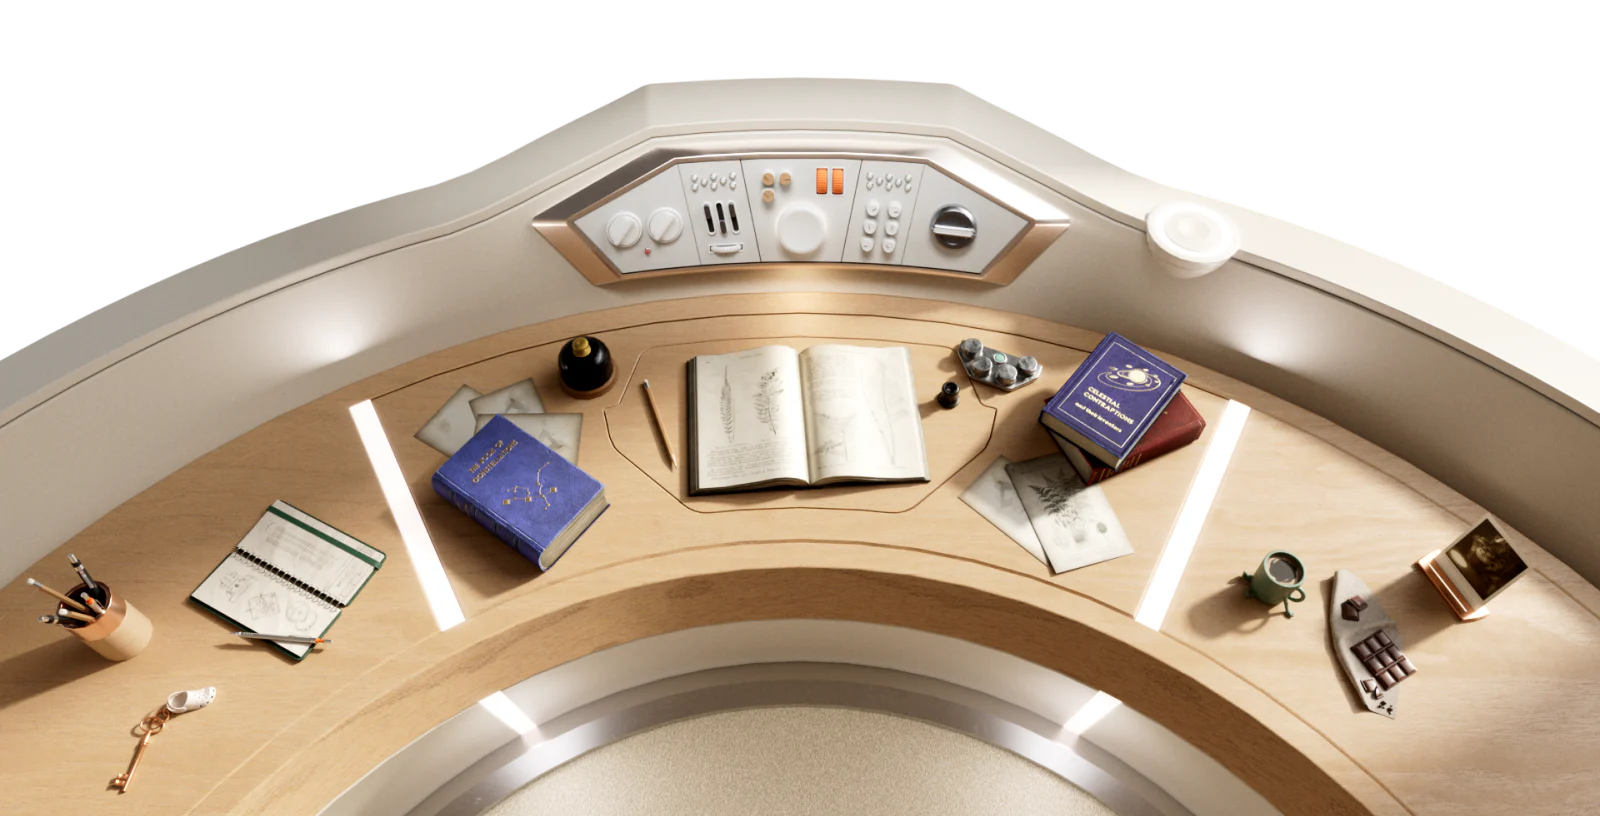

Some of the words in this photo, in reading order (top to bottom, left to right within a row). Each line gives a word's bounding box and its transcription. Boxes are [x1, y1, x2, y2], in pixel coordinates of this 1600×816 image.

[1074, 402, 1086, 411] and
[1085, 407, 1098, 418] their
[1083, 391, 1134, 424] CONTRAPTIONS
[1088, 386, 1120, 409] CELESTIAL
[468, 462, 480, 474] THE
[478, 447, 496, 464] BOOK
[494, 439, 504, 449] OF
[472, 439, 519, 483] CONSTELLATIONS
